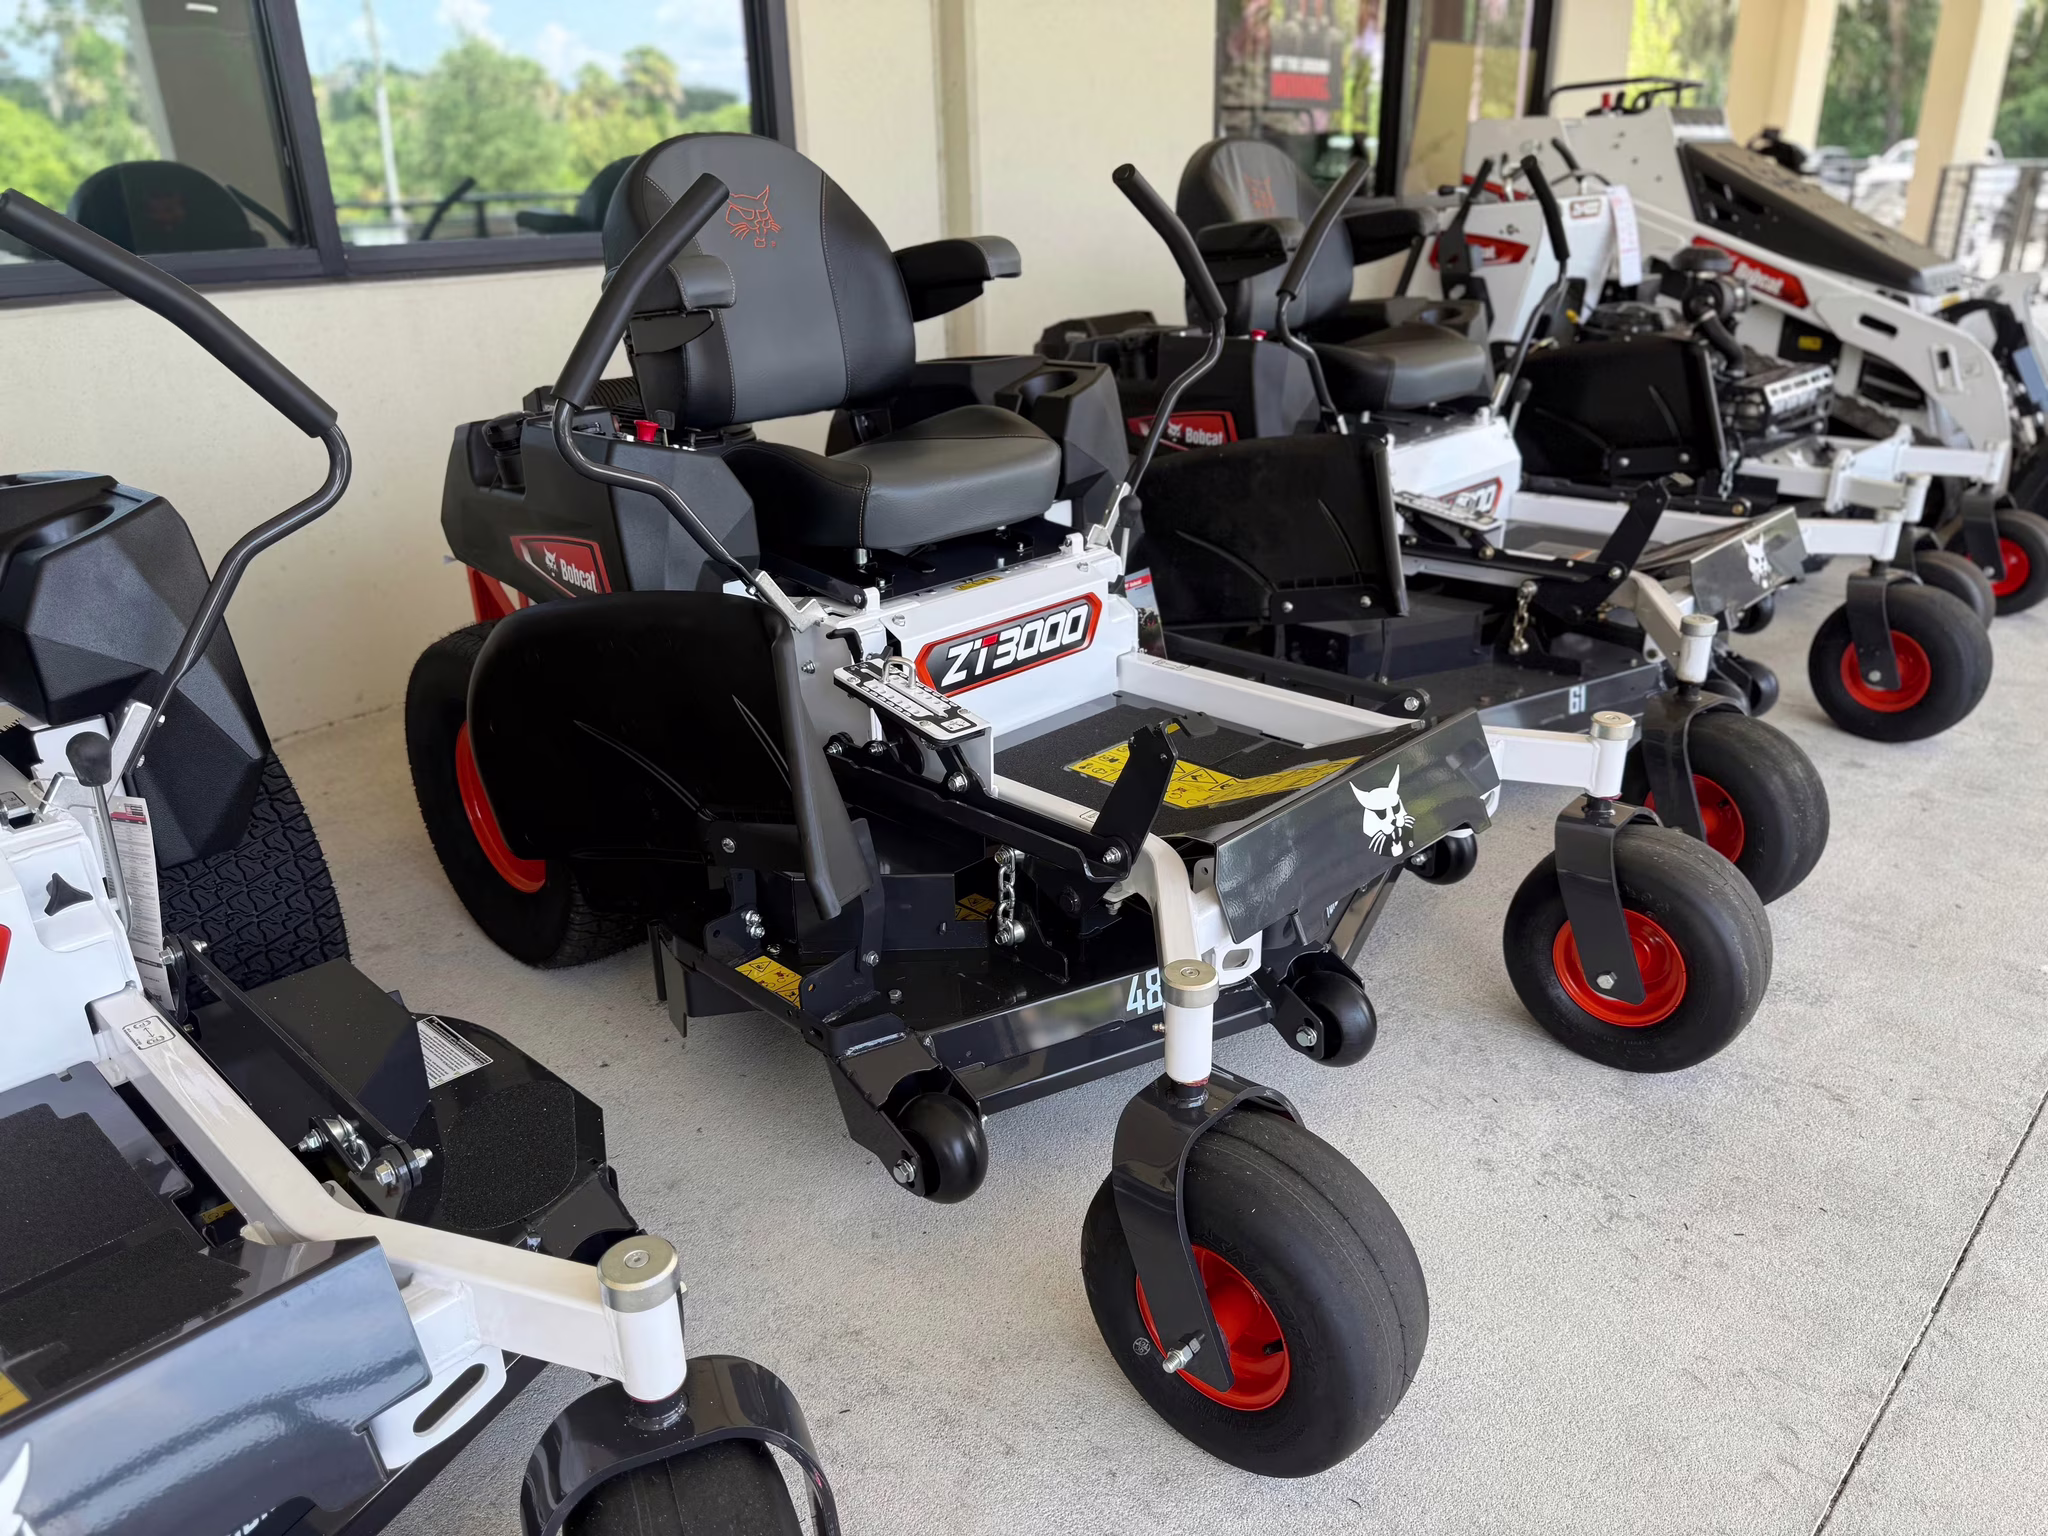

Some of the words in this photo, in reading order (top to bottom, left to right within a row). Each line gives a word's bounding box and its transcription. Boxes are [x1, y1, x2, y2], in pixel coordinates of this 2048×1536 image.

[1184, 426, 1224, 446] Bobcat
[559, 558, 598, 594] Bobcat
[940, 603, 1090, 688] ZT3000
[1569, 684, 1587, 715] 61
[1126, 966, 1164, 1015] 48
